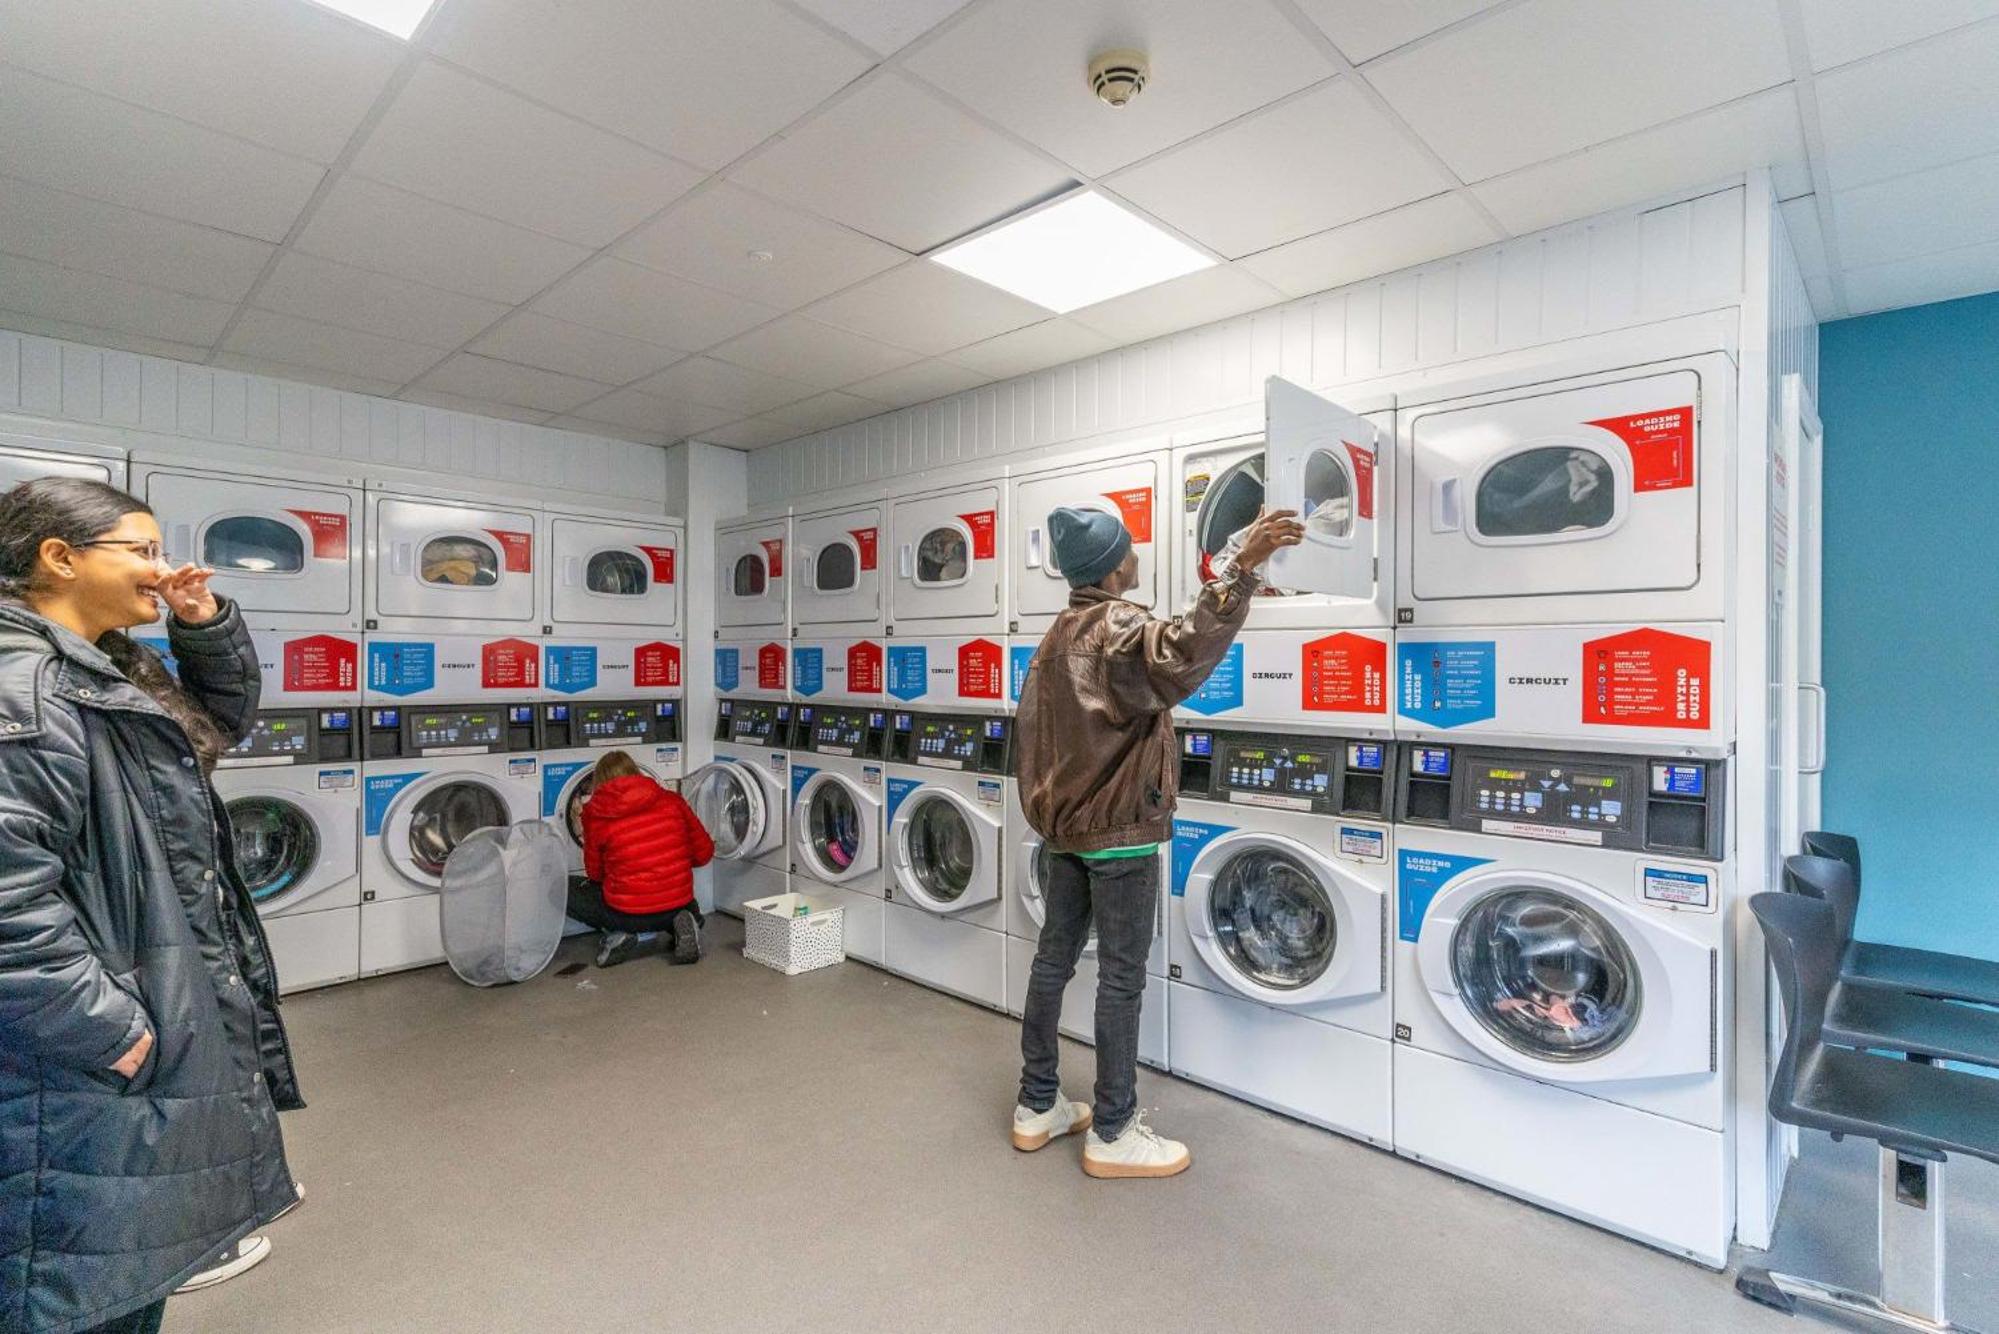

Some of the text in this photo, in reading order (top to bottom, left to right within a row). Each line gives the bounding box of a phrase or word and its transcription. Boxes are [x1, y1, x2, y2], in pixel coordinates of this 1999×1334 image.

[1630, 414, 1681, 428] LOADING
[1643, 421, 1680, 432] GUIDE
[1400, 611, 1412, 621] 19
[1364, 664, 1372, 705] DRYING
[1508, 677, 1568, 685] CIRCUIT
[1413, 674, 1421, 709] GUIDE
[1676, 668, 1687, 719] DRYING
[1689, 677, 1700, 720] GUIDE
[1406, 856, 1451, 868] LOADING
[1406, 863, 1438, 873] GUIDE
[1397, 1027, 1410, 1037] 20
